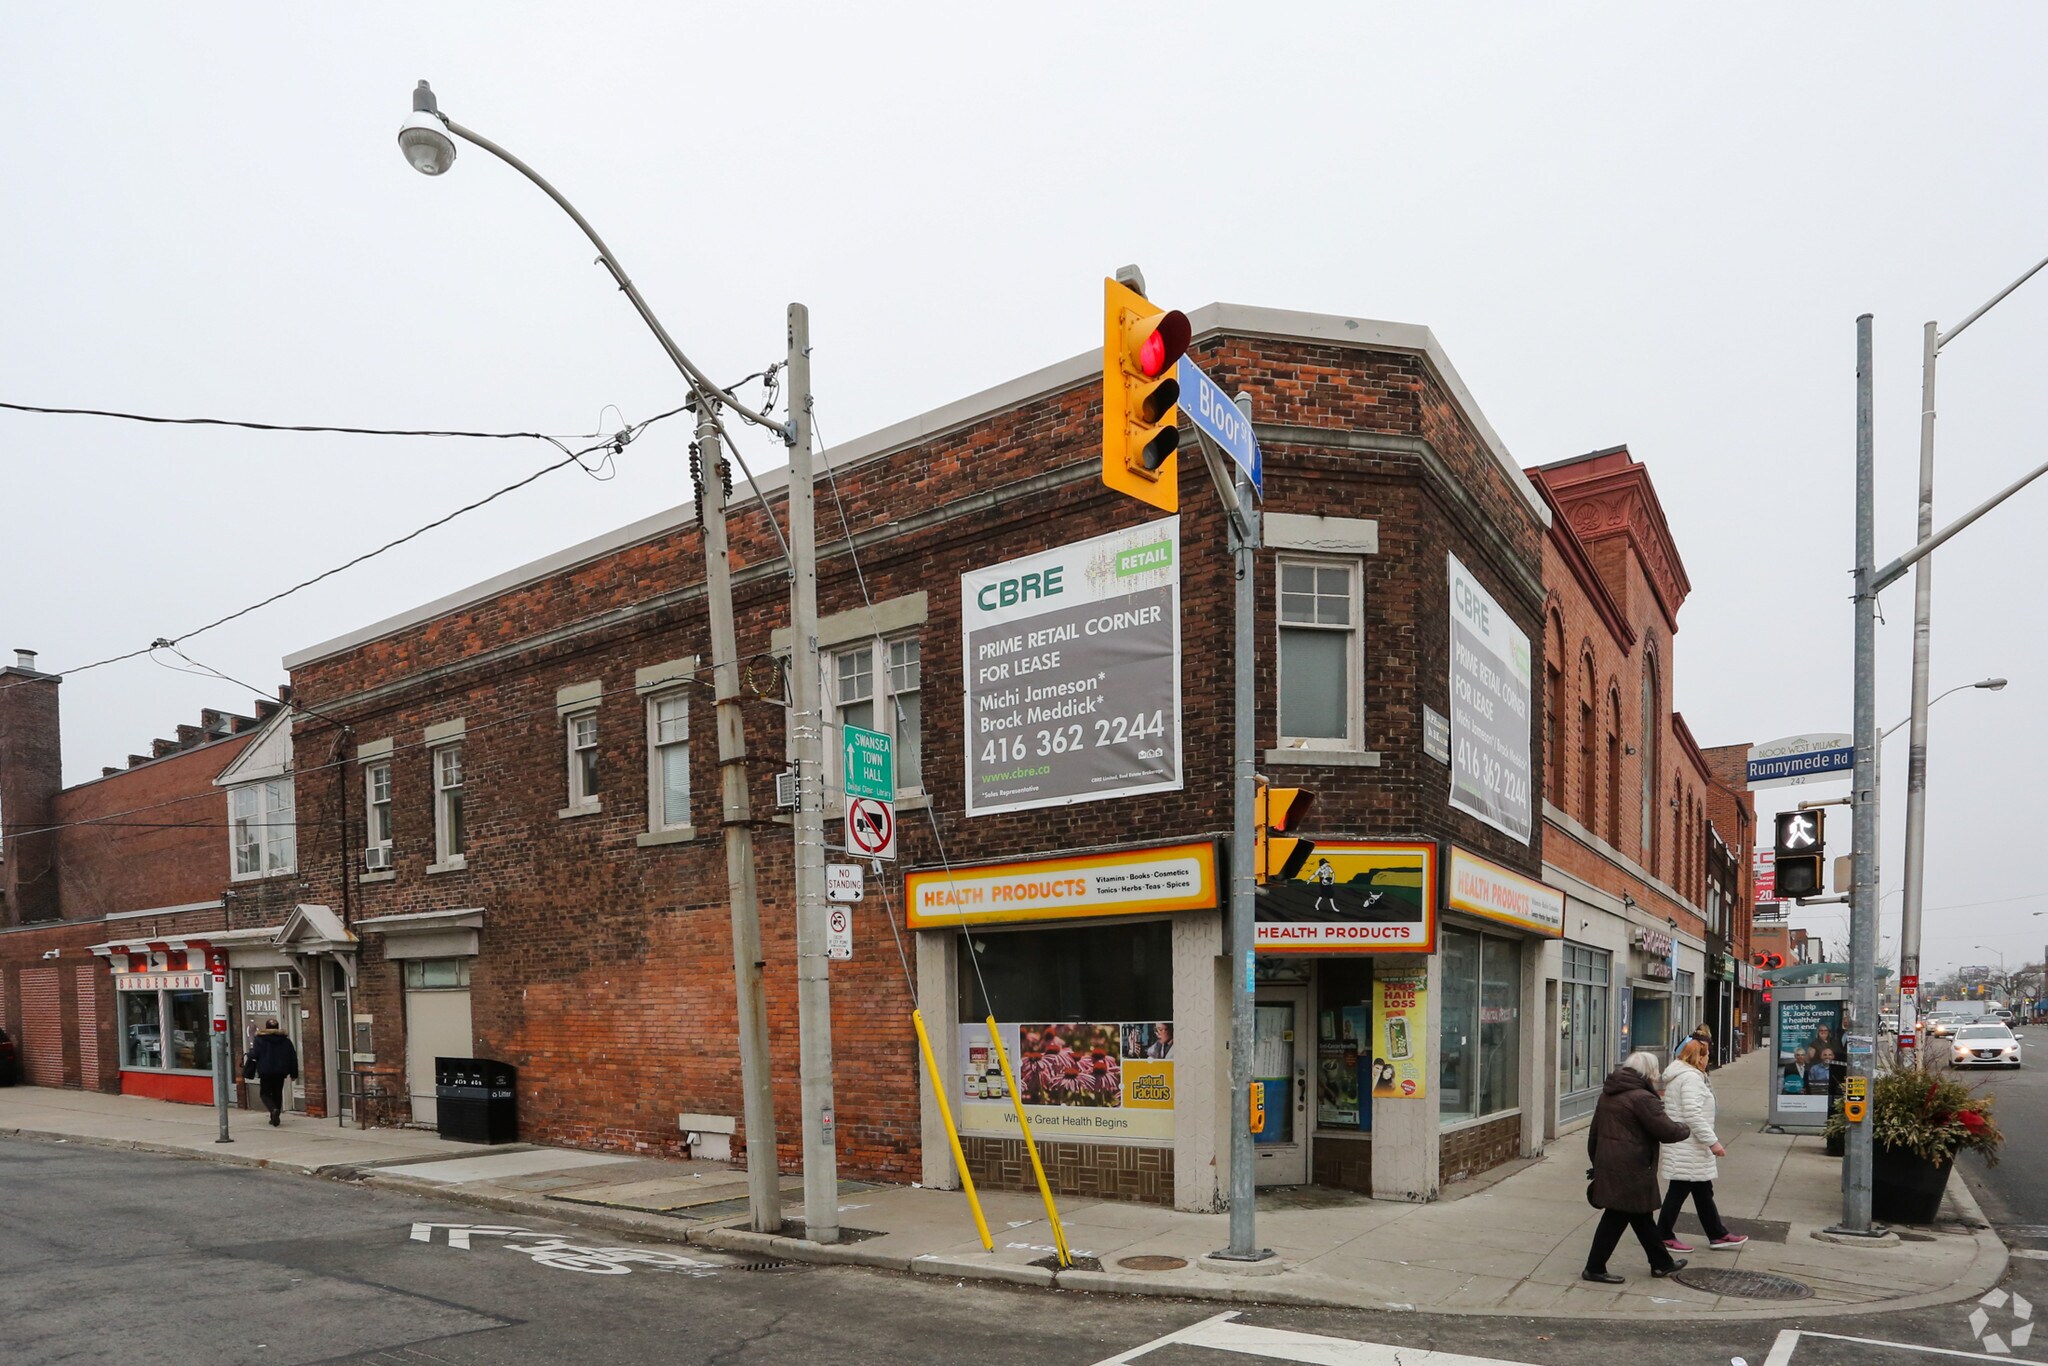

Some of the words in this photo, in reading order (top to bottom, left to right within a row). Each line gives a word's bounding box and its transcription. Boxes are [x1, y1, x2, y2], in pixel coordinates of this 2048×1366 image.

[1200, 378, 1240, 445] Bloor
[1121, 547, 1168, 570] RETAIL
[977, 566, 1064, 611] CBRE
[1455, 577, 1490, 637] CBRE
[979, 635, 1022, 660] PRIME
[1028, 623, 1079, 648] RETAIL
[1085, 605, 1161, 636] CORNER
[979, 661, 1009, 684] FOR
[1014, 651, 1060, 677] LEASE
[1456, 640, 1478, 677] PRIME
[1480, 662, 1501, 698] RETAIL
[1502, 683, 1526, 720] CORNER
[980, 688, 1019, 712] Michi
[1455, 674, 1472, 705] FOR
[1473, 688, 1494, 721] LEASE
[980, 709, 1023, 733] Brock
[855, 733, 889, 752] SWANSEA
[980, 735, 1026, 765] 416
[1036, 724, 1084, 756] 362
[1095, 710, 1165, 747] 2244
[1788, 743, 1810, 754] WEST
[862, 750, 883, 766] TOWN
[1750, 754, 1829, 776] Runnymede
[1834, 753, 1848, 765] Rd
[863, 767, 883, 782] HALL
[982, 764, 1051, 783] www.cbre.ca
[1458, 737, 1479, 779] 416
[1483, 753, 1500, 793] 362
[1504, 768, 1526, 809] 2244
[1790, 777, 1806, 785] 242
[1000, 785, 1039, 797] Representative
[839, 869, 850, 878] NO
[1096, 875, 1125, 883] Vitamins
[1130, 872, 1150, 880] Books
[1154, 868, 1189, 878] Cosmetics
[828, 880, 861, 889] STANDING
[925, 888, 984, 907] HEALTH
[992, 879, 1087, 902] PRODUCTS
[1166, 881, 1190, 889] Spices
[1458, 870, 1489, 901] HEALTH
[1491, 883, 1529, 915] PRODUCTS
[1258, 927, 1317, 938] HEALTH
[1325, 927, 1410, 938] PRODUCTS
[120, 977, 167, 989] BARBER
[250, 984, 271, 995] SHOE
[1384, 983, 1416, 991] STOP
[246, 1000, 277, 1011] REPAIR
[1384, 1000, 1416, 1008] LOSS
[1140, 1075, 1164, 1086] natural
[1133, 1082, 1171, 1099] Factors
[1004, 1113, 1032, 1123] Whe
[1035, 1115, 1059, 1125] Great
[1063, 1116, 1092, 1126] Health
[1095, 1117, 1128, 1129] Begins
